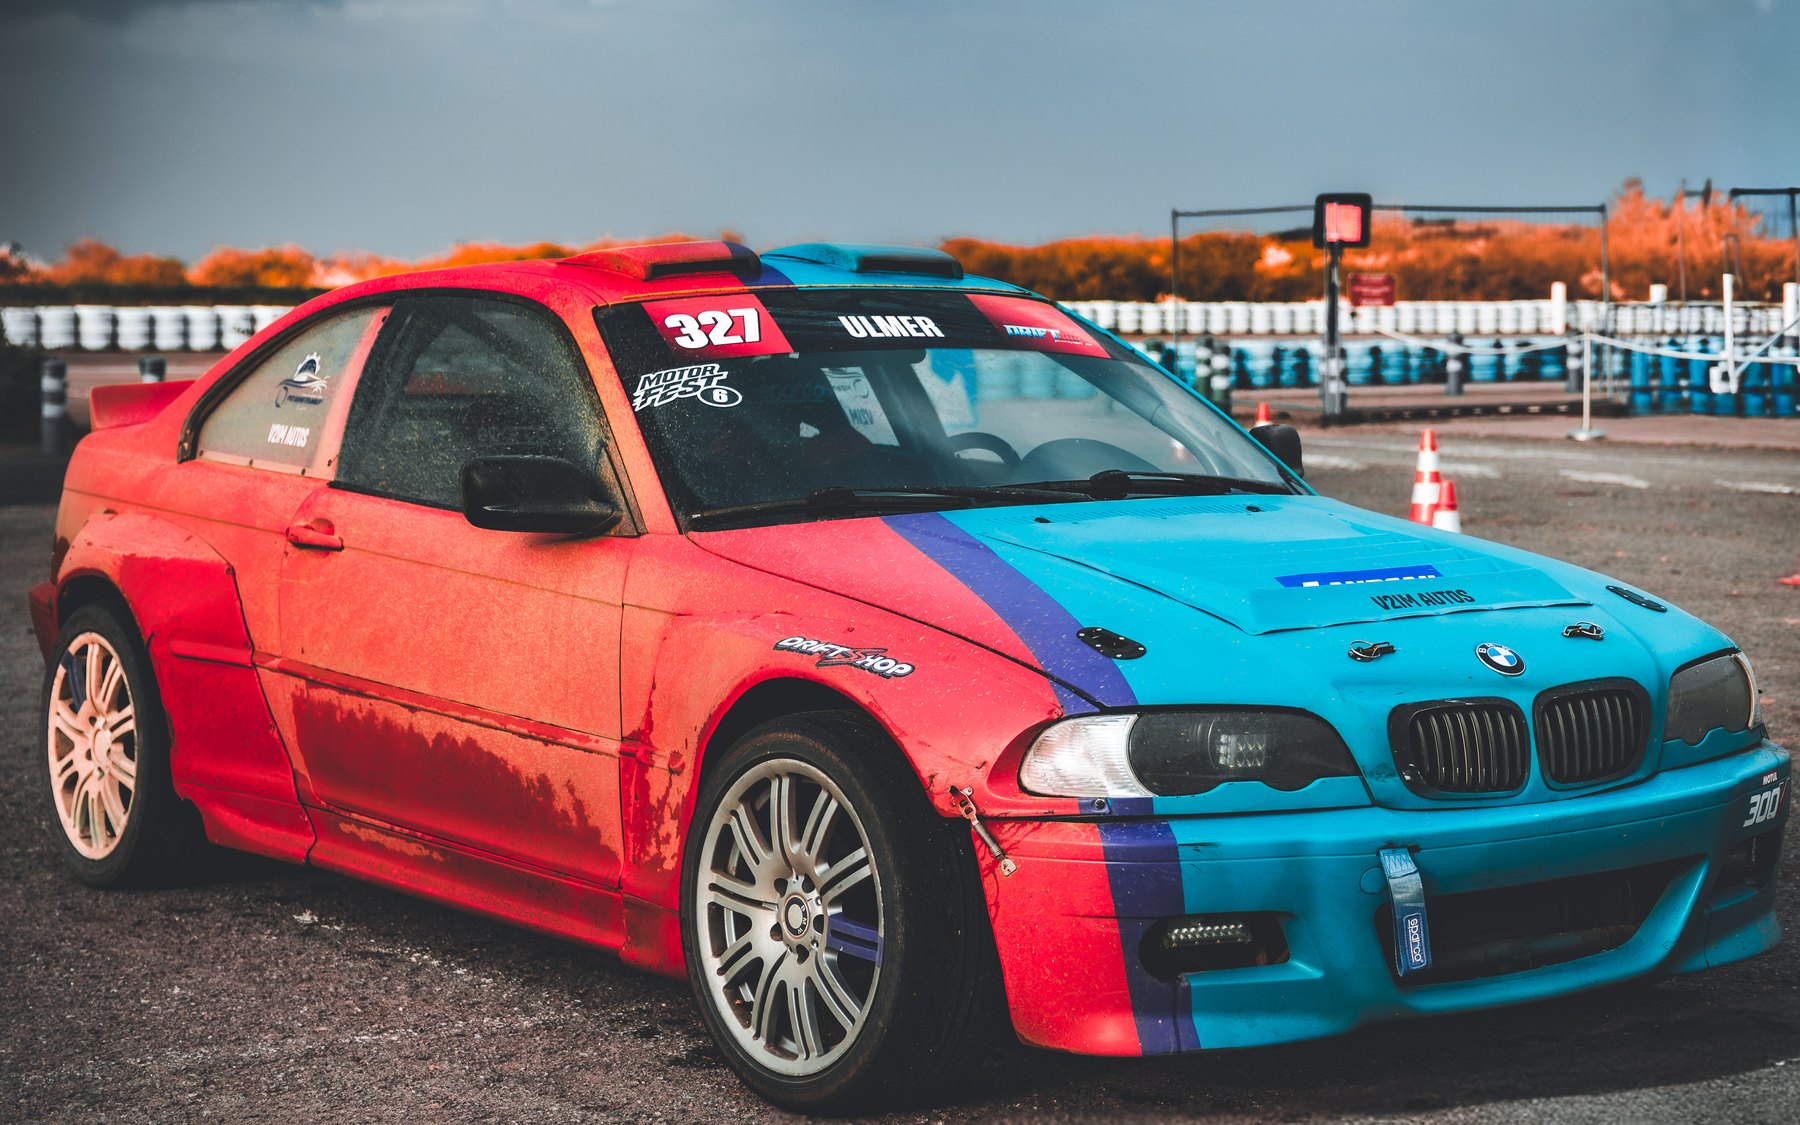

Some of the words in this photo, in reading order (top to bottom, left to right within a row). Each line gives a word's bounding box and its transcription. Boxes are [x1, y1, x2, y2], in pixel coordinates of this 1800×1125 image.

[664, 307, 761, 349] 327
[837, 315, 945, 338] ULMER
[632, 371, 728, 411] FEST
[633, 363, 720, 396] MOTOR
[712, 388, 729, 403] 6
[283, 425, 310, 448] AUTOS
[1416, 589, 1476, 607] AUTOS
